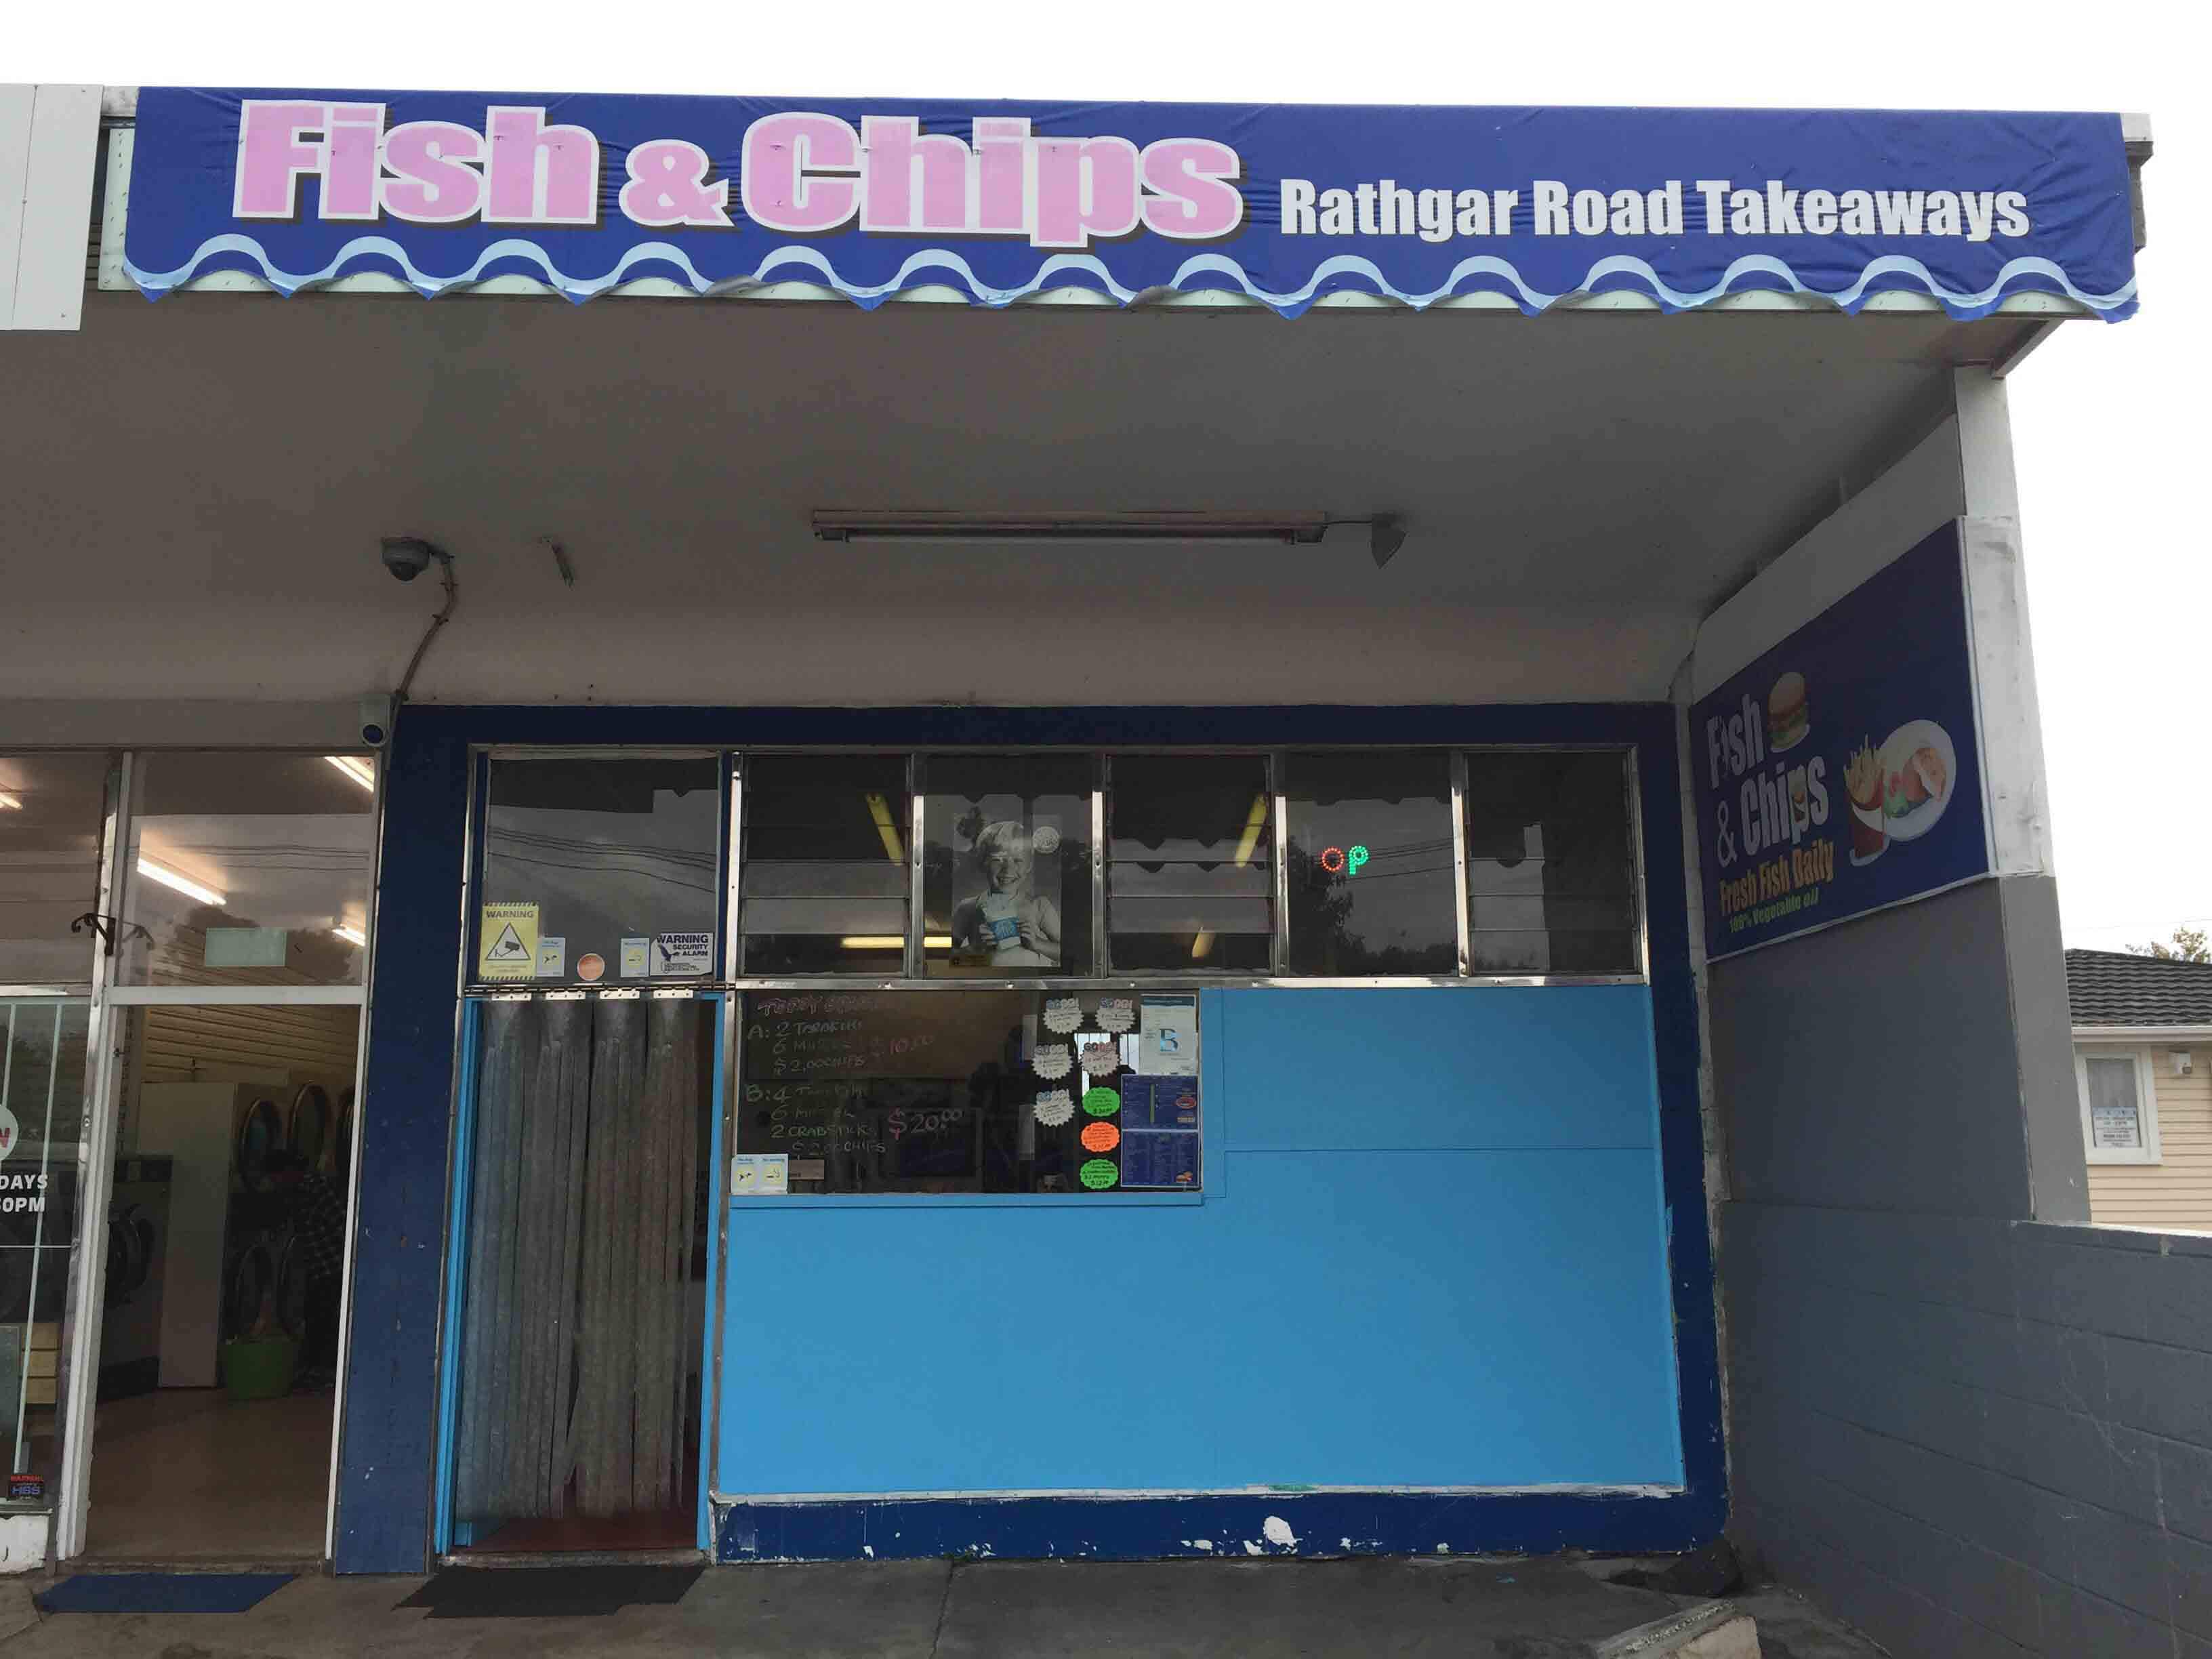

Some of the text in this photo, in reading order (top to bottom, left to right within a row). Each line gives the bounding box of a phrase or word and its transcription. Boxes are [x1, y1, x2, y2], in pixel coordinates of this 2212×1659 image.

[232, 99, 1244, 248] Fish & Chips
[1280, 178, 2030, 243] Rathgar Road Takeaways
[1706, 693, 1763, 790] Fish
[1717, 755, 1829, 868] & Chips
[1719, 838, 1834, 916] Fresh Fish Daily
[656, 935, 709, 943] WARNING
[0, 1197, 46, 1213] 0PM
